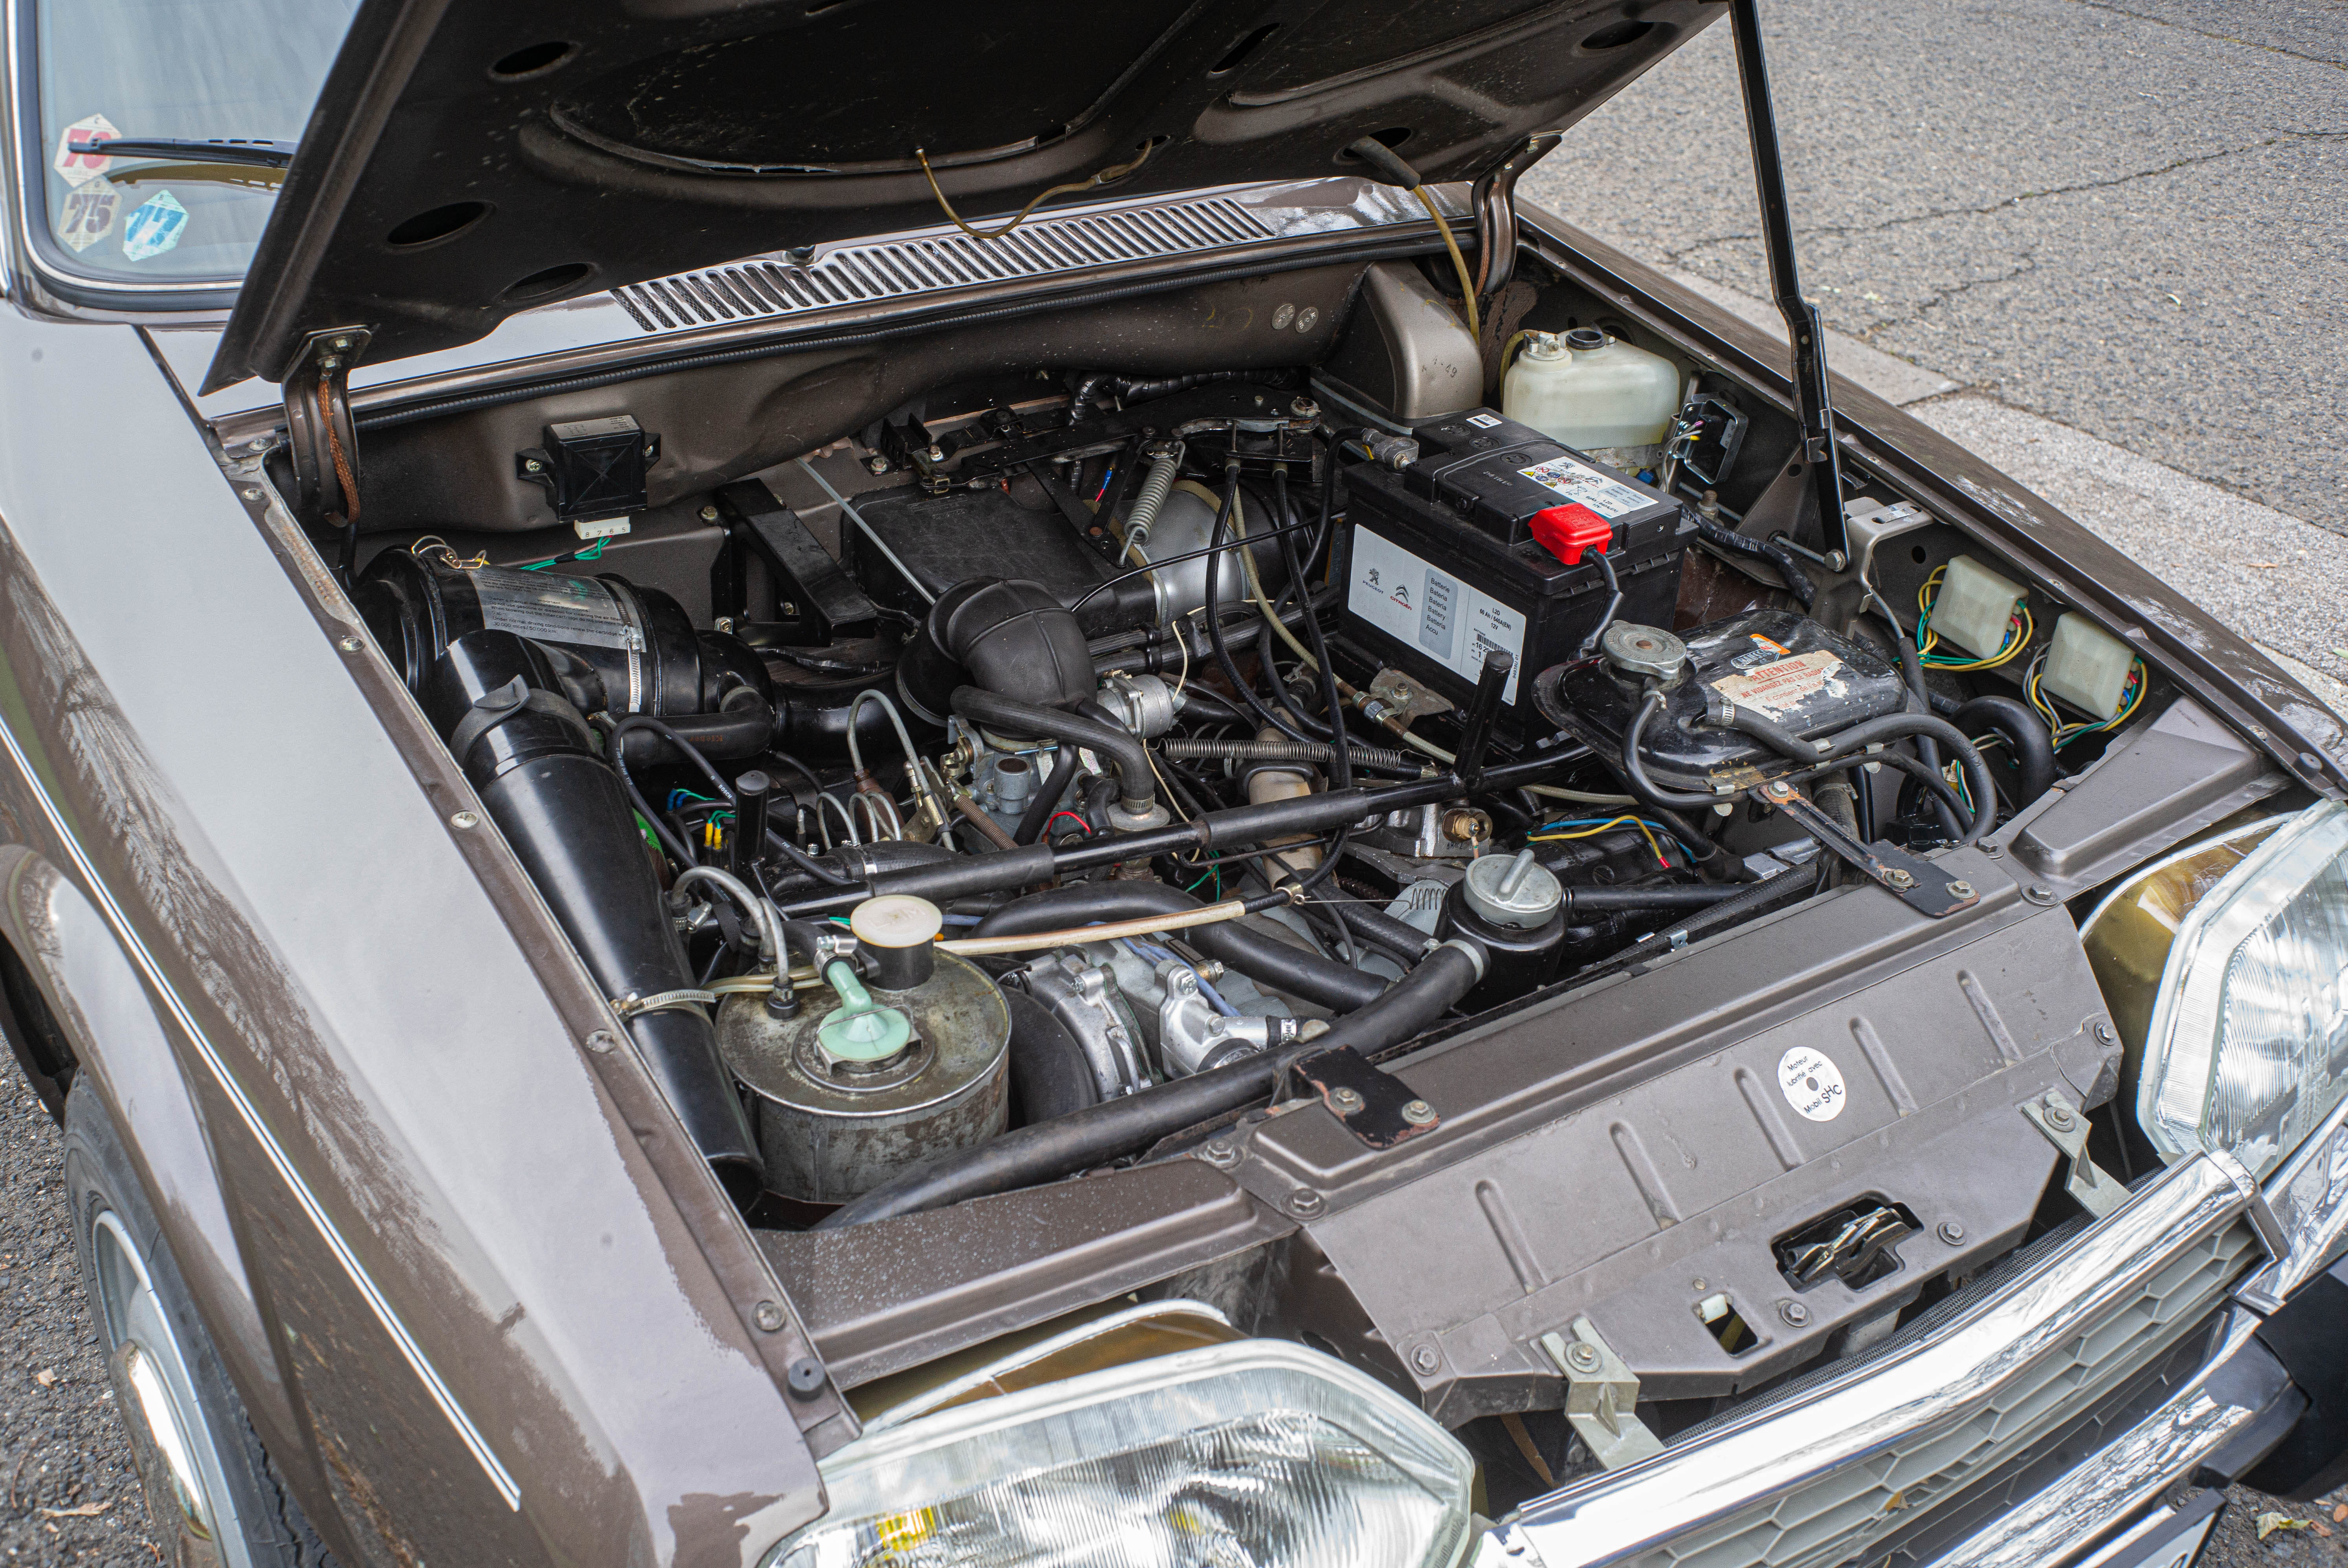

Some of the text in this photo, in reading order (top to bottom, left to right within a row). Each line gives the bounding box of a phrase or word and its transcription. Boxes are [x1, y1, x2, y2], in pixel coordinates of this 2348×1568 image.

[65, 194, 116, 233] 75
[125, 204, 183, 248] 77
[1362, 580, 1384, 594] PEUGEOT
[1431, 577, 1450, 593] Batterie
[1428, 605, 1445, 621] Battery
[1492, 608, 1500, 616] L2D
[1425, 624, 1438, 636] Accu
[1427, 614, 1446, 630] Batteria
[1751, 660, 1806, 681] ATTENTION
[1751, 680, 1783, 694] VIDANGEZ
[718, 784, 733, 799] BOSCH
[1787, 1056, 1808, 1072] Moteur
[1787, 1061, 1823, 1086] lubrifié avec
[1803, 1084, 1842, 1114] Mobil SHC
